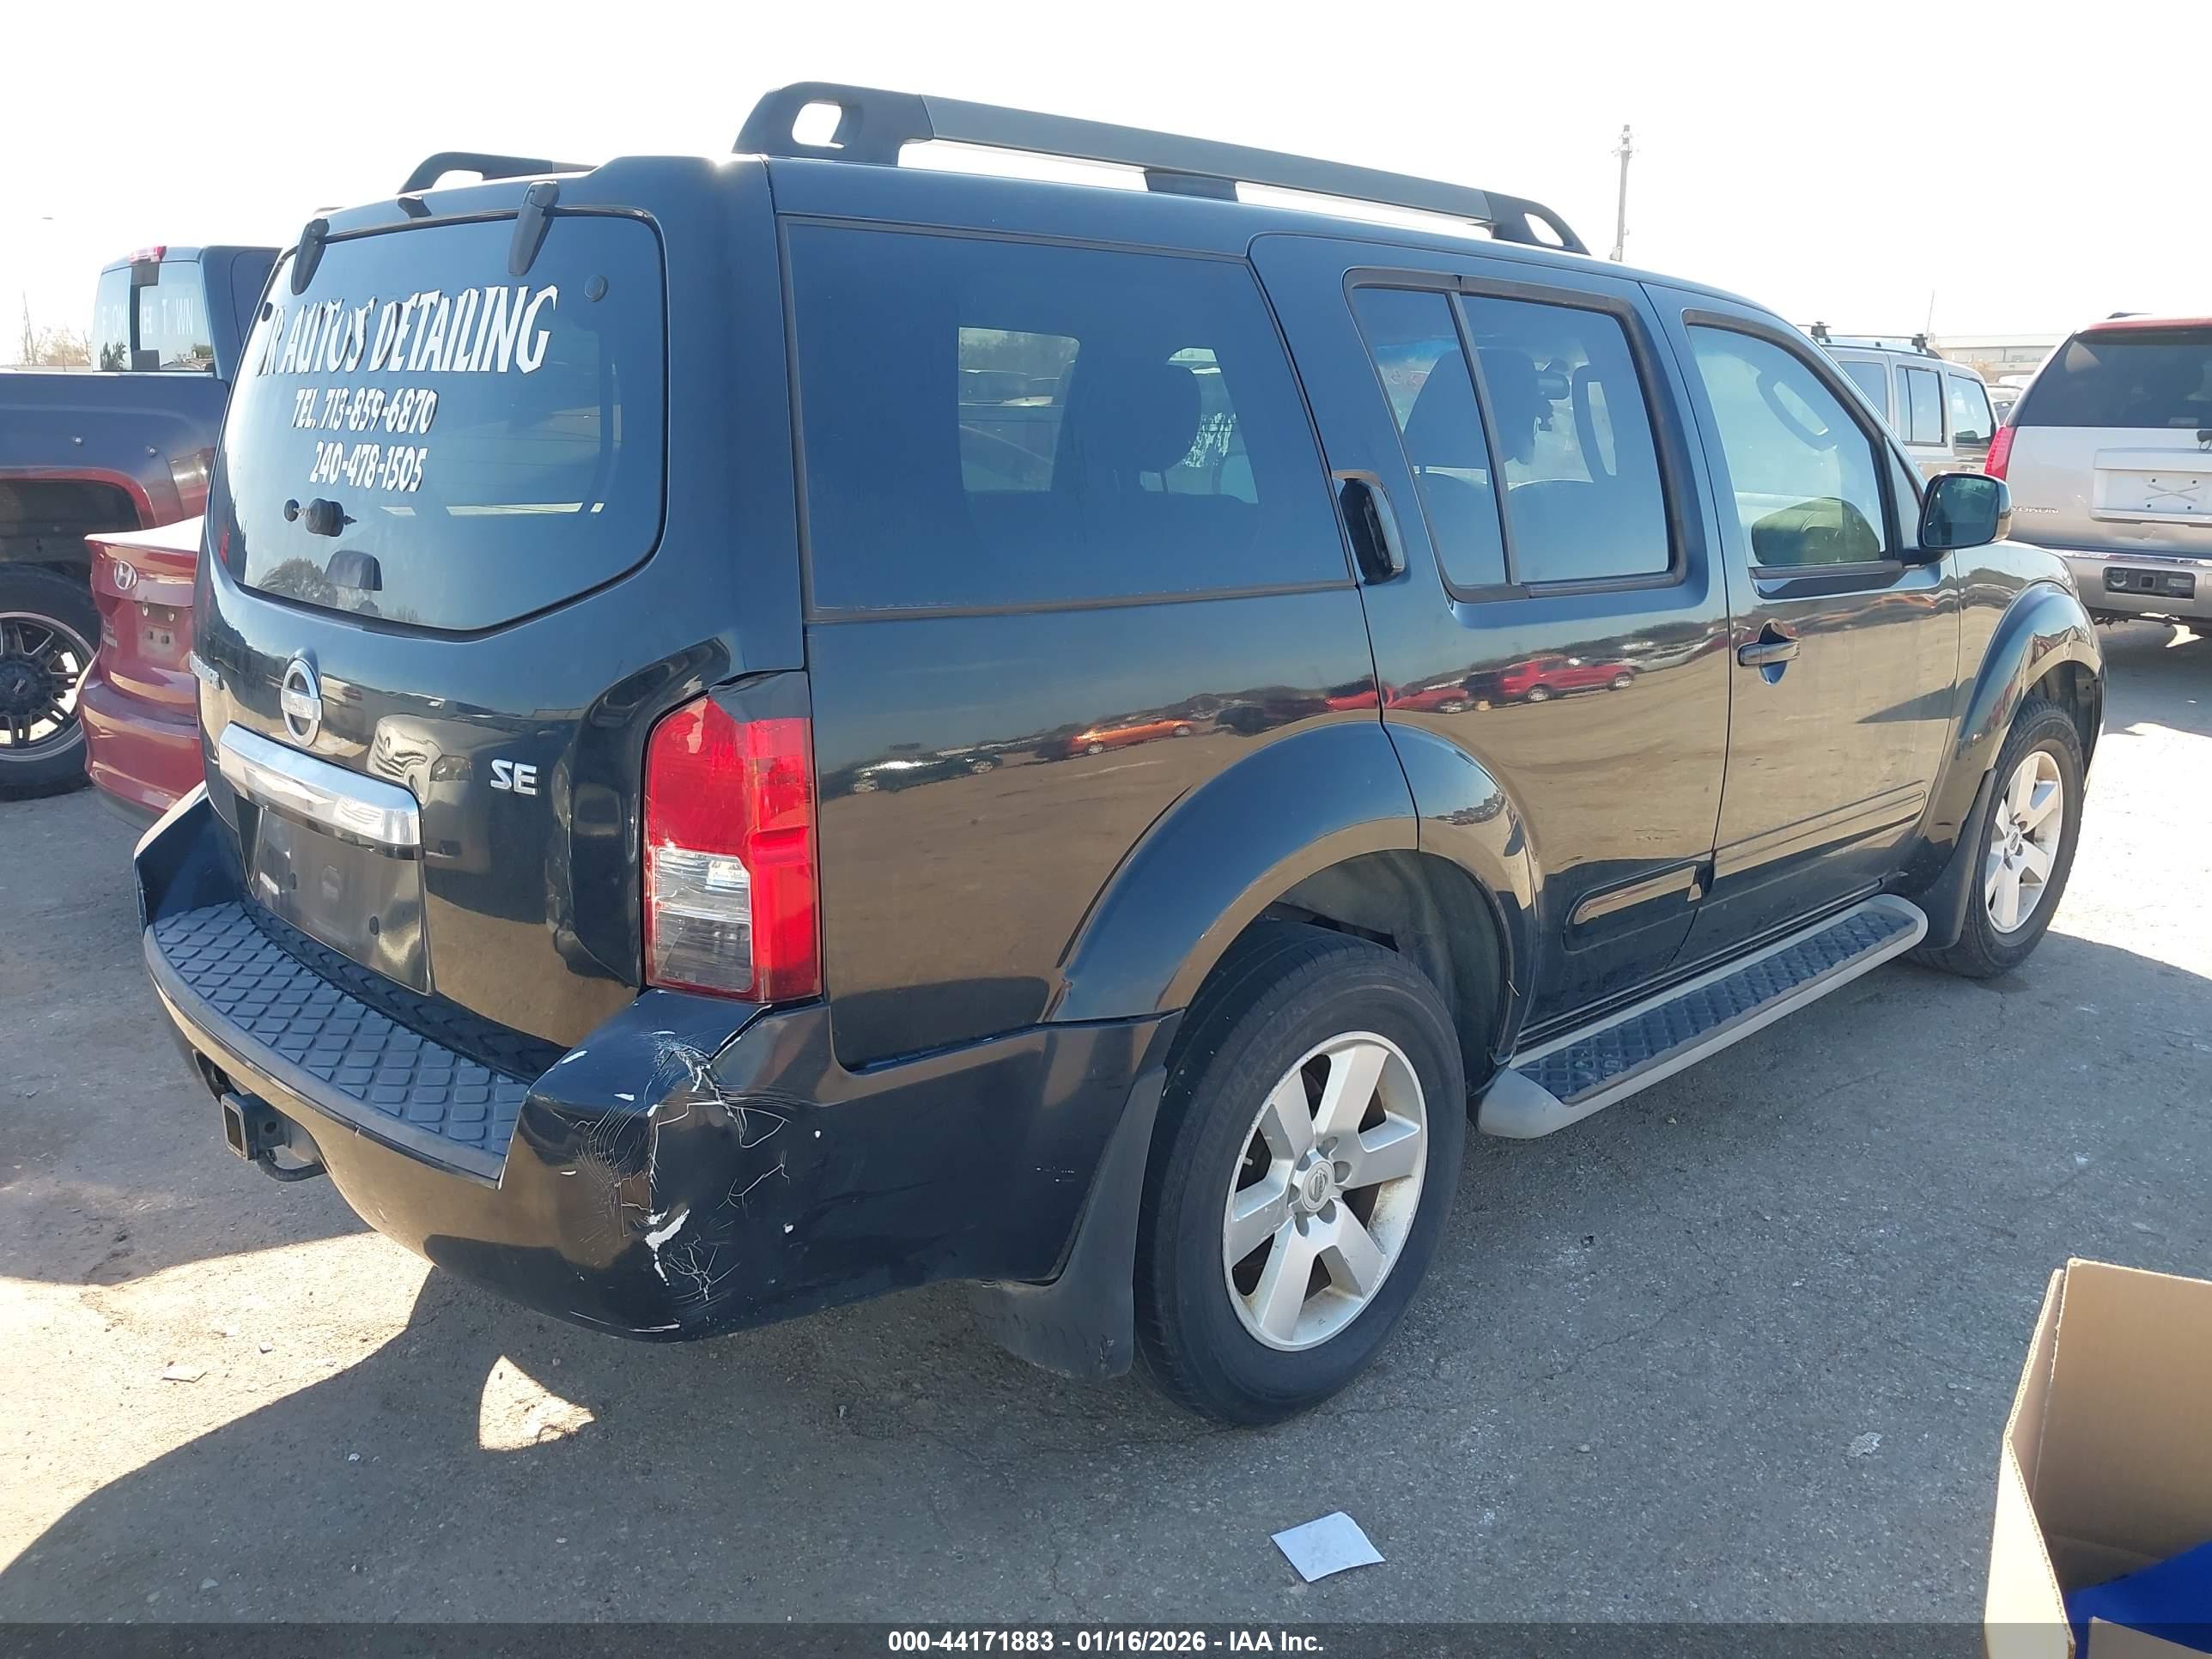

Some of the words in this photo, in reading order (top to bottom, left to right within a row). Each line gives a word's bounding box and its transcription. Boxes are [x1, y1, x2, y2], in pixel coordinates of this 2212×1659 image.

[161, 298, 193, 336] TWN
[278, 296, 377, 374] AUTOS
[368, 284, 558, 374] DETAILING
[320, 386, 439, 434] 713-859-6870
[308, 440, 428, 493] 240-478-1505
[490, 759, 537, 795] SE
